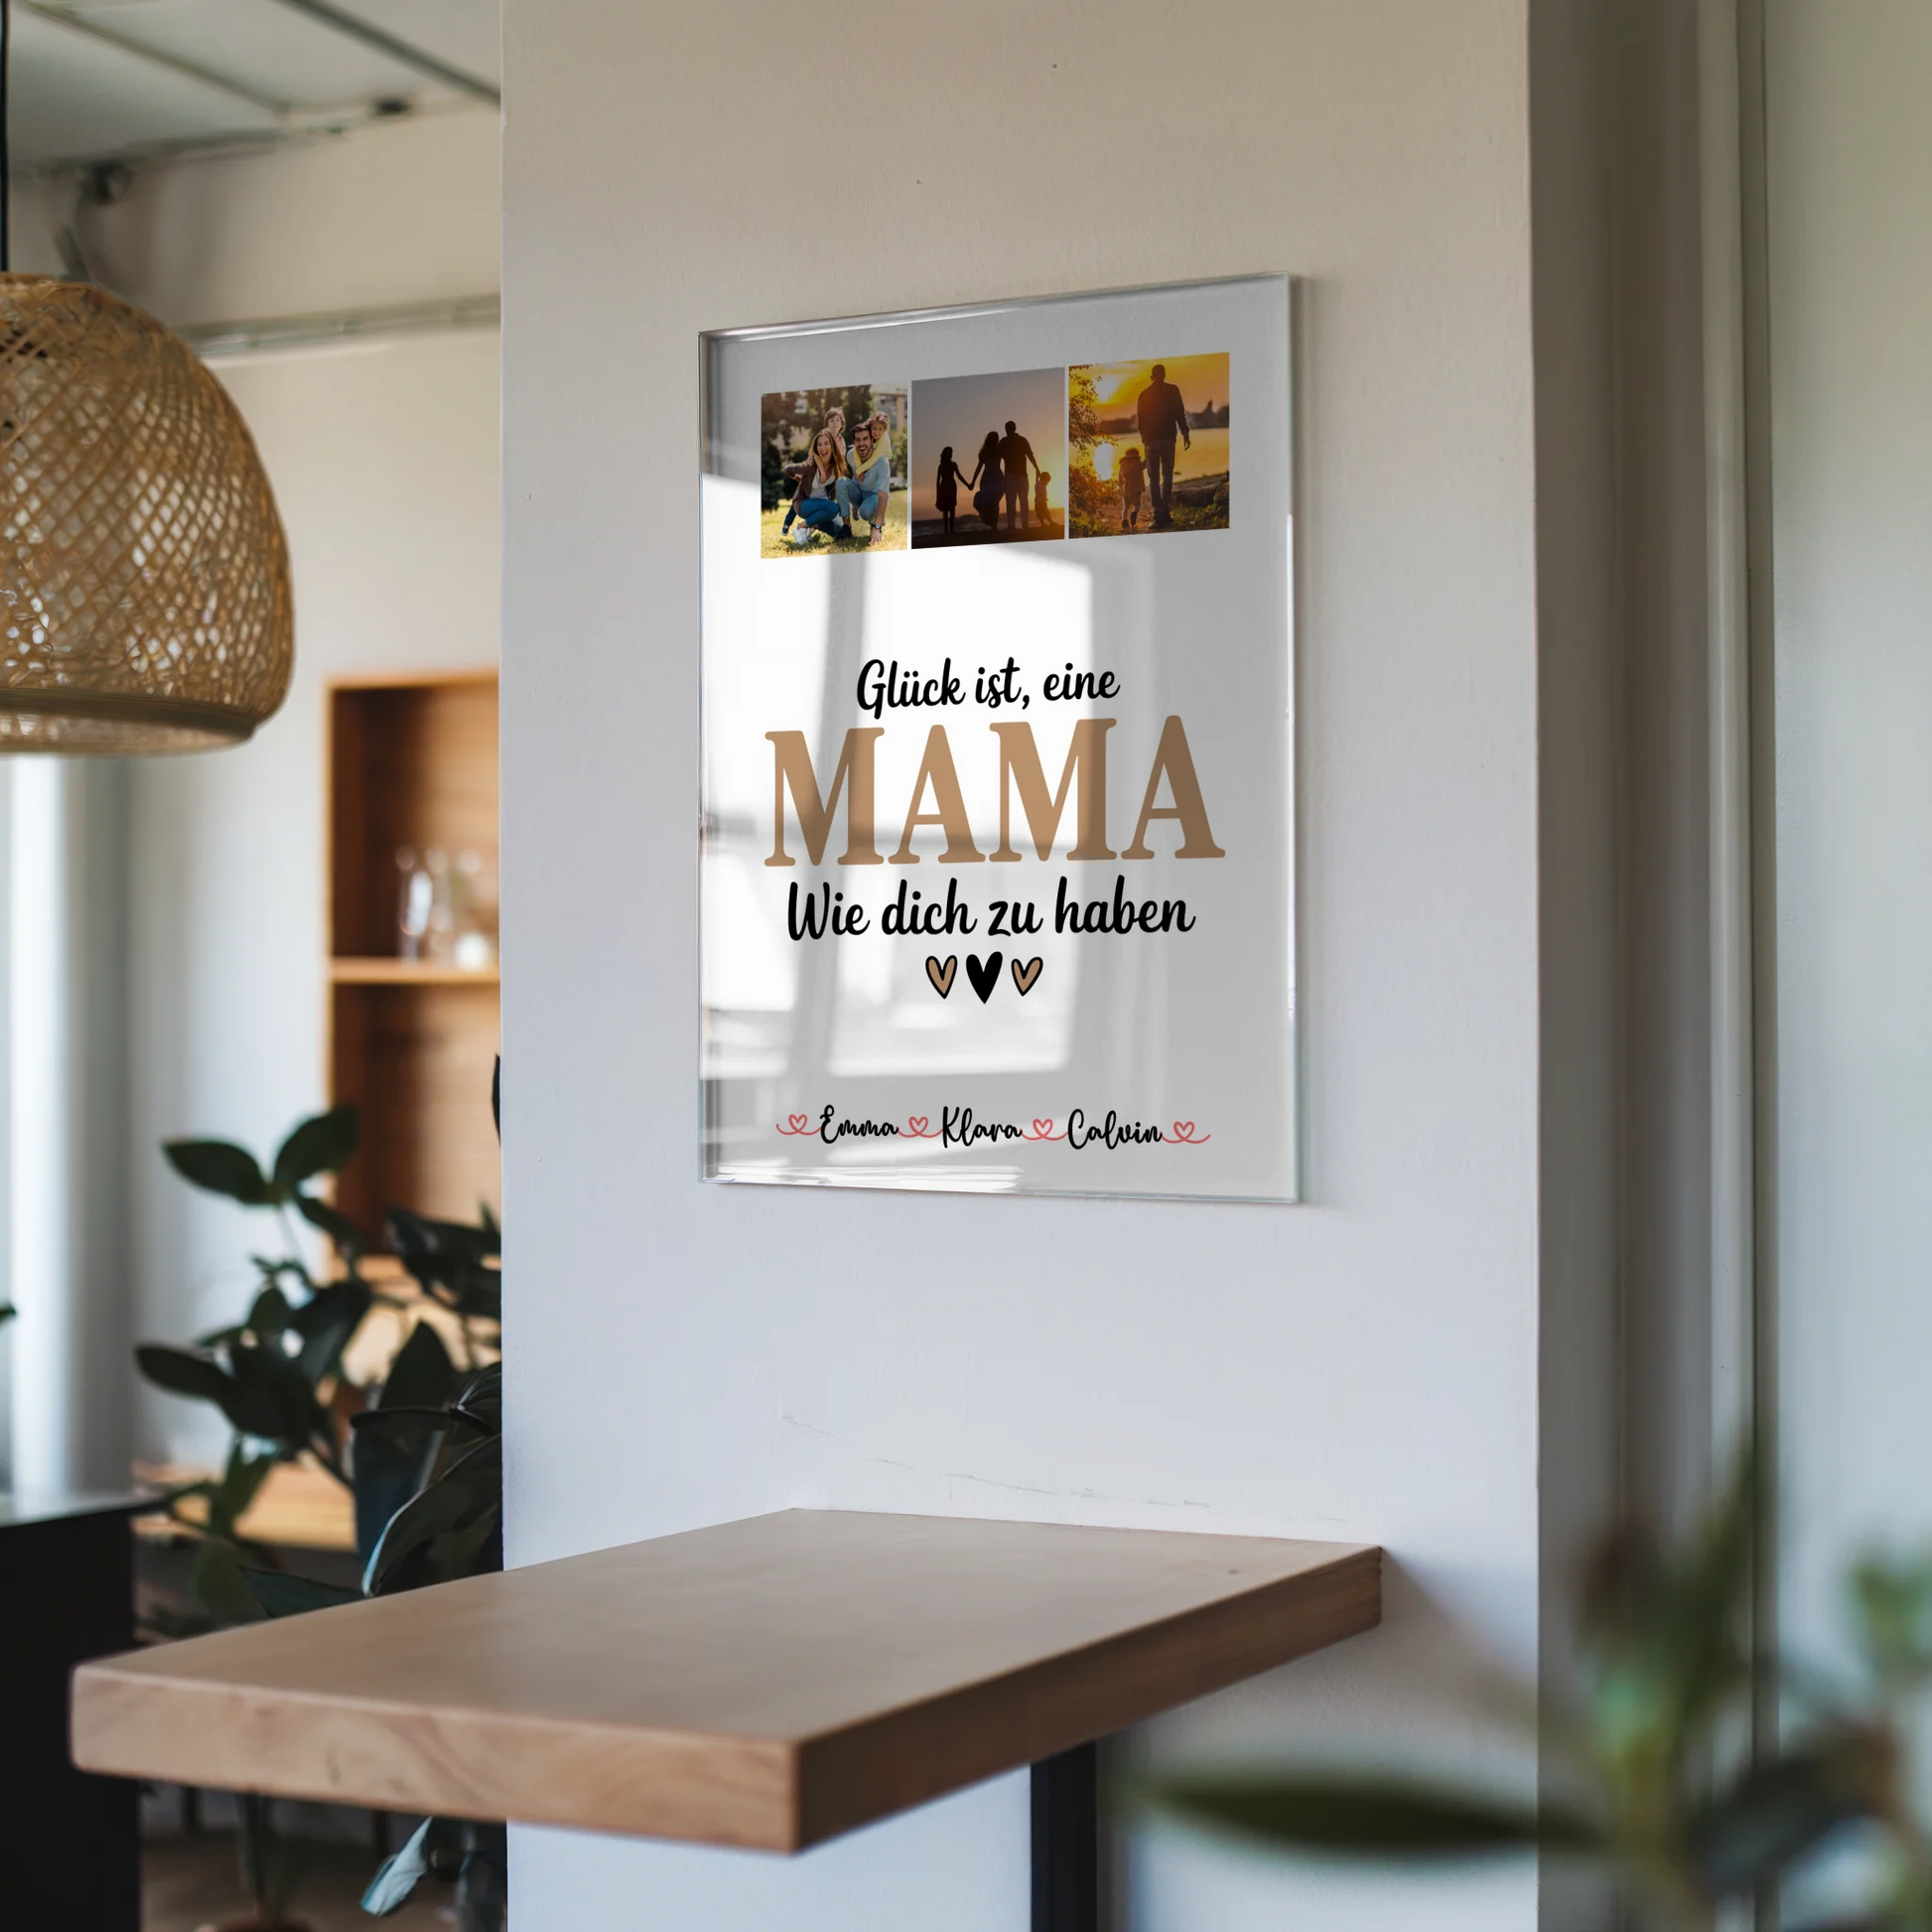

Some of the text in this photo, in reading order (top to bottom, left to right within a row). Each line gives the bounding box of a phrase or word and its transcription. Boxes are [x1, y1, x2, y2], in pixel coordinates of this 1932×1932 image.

[856, 656, 1121, 720] Glück ist, eine
[764, 715, 1226, 867] MAMA
[787, 874, 1197, 941] Wie dich zu haben
[819, 1104, 1164, 1151] Emma Klara Calvin
